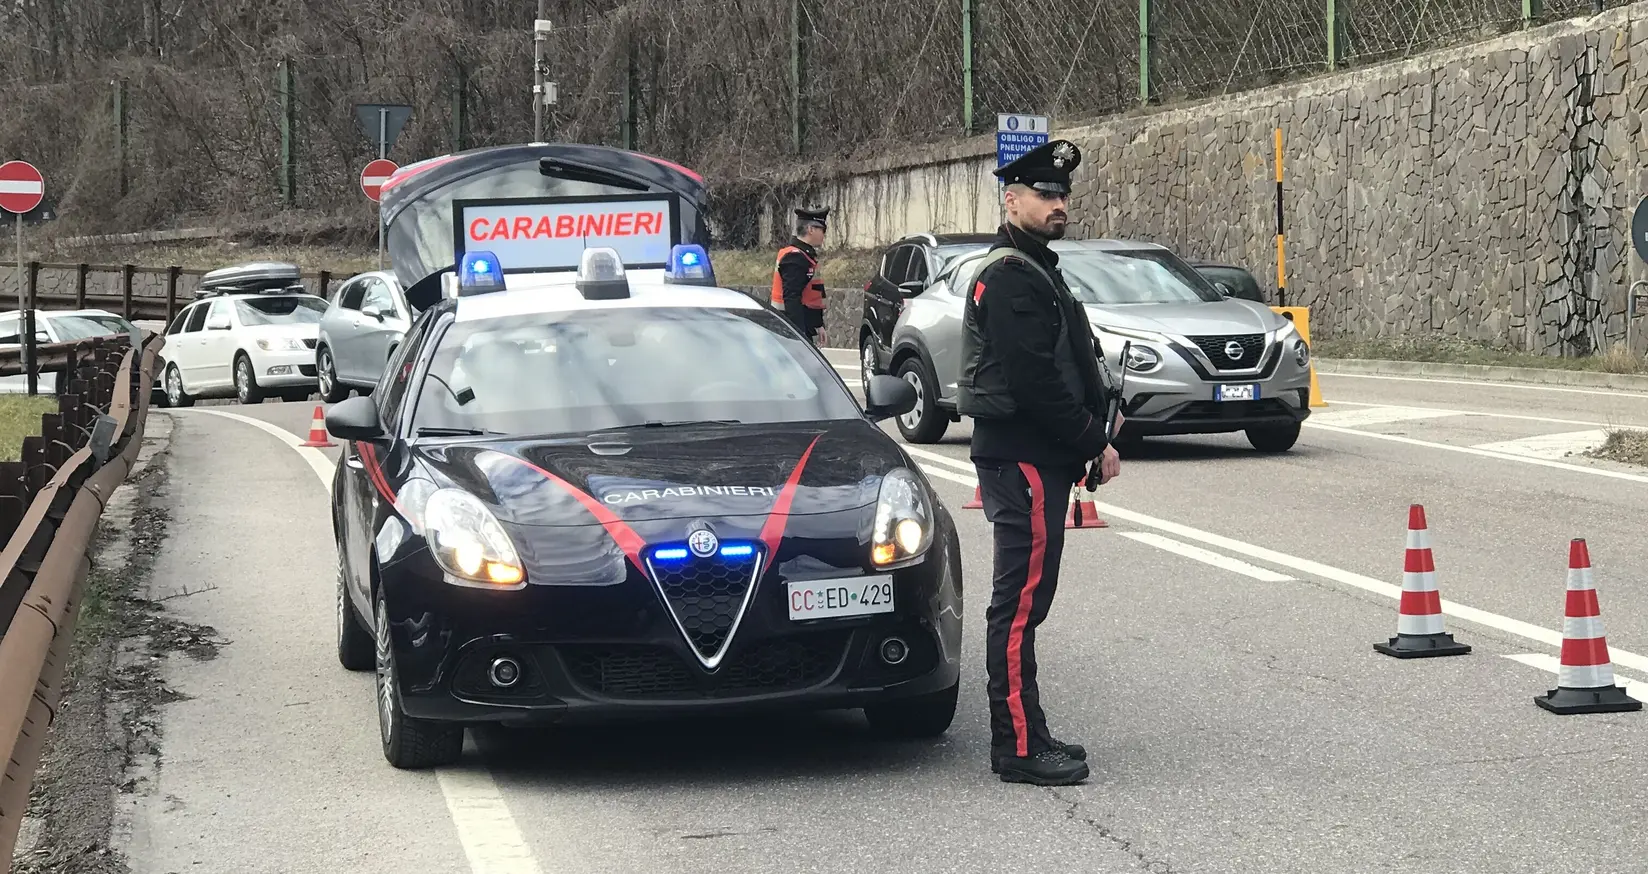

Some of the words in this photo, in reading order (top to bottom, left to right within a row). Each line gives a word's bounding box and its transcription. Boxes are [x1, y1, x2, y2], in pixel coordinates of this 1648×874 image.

[1001, 134, 1034, 143] OBBLIGO
[470, 212, 663, 241] CARABINIERI
[603, 485, 775, 505] CARABINIERI
[791, 589, 815, 612] CC
[826, 587, 849, 609] ED
[858, 584, 892, 606] 429
